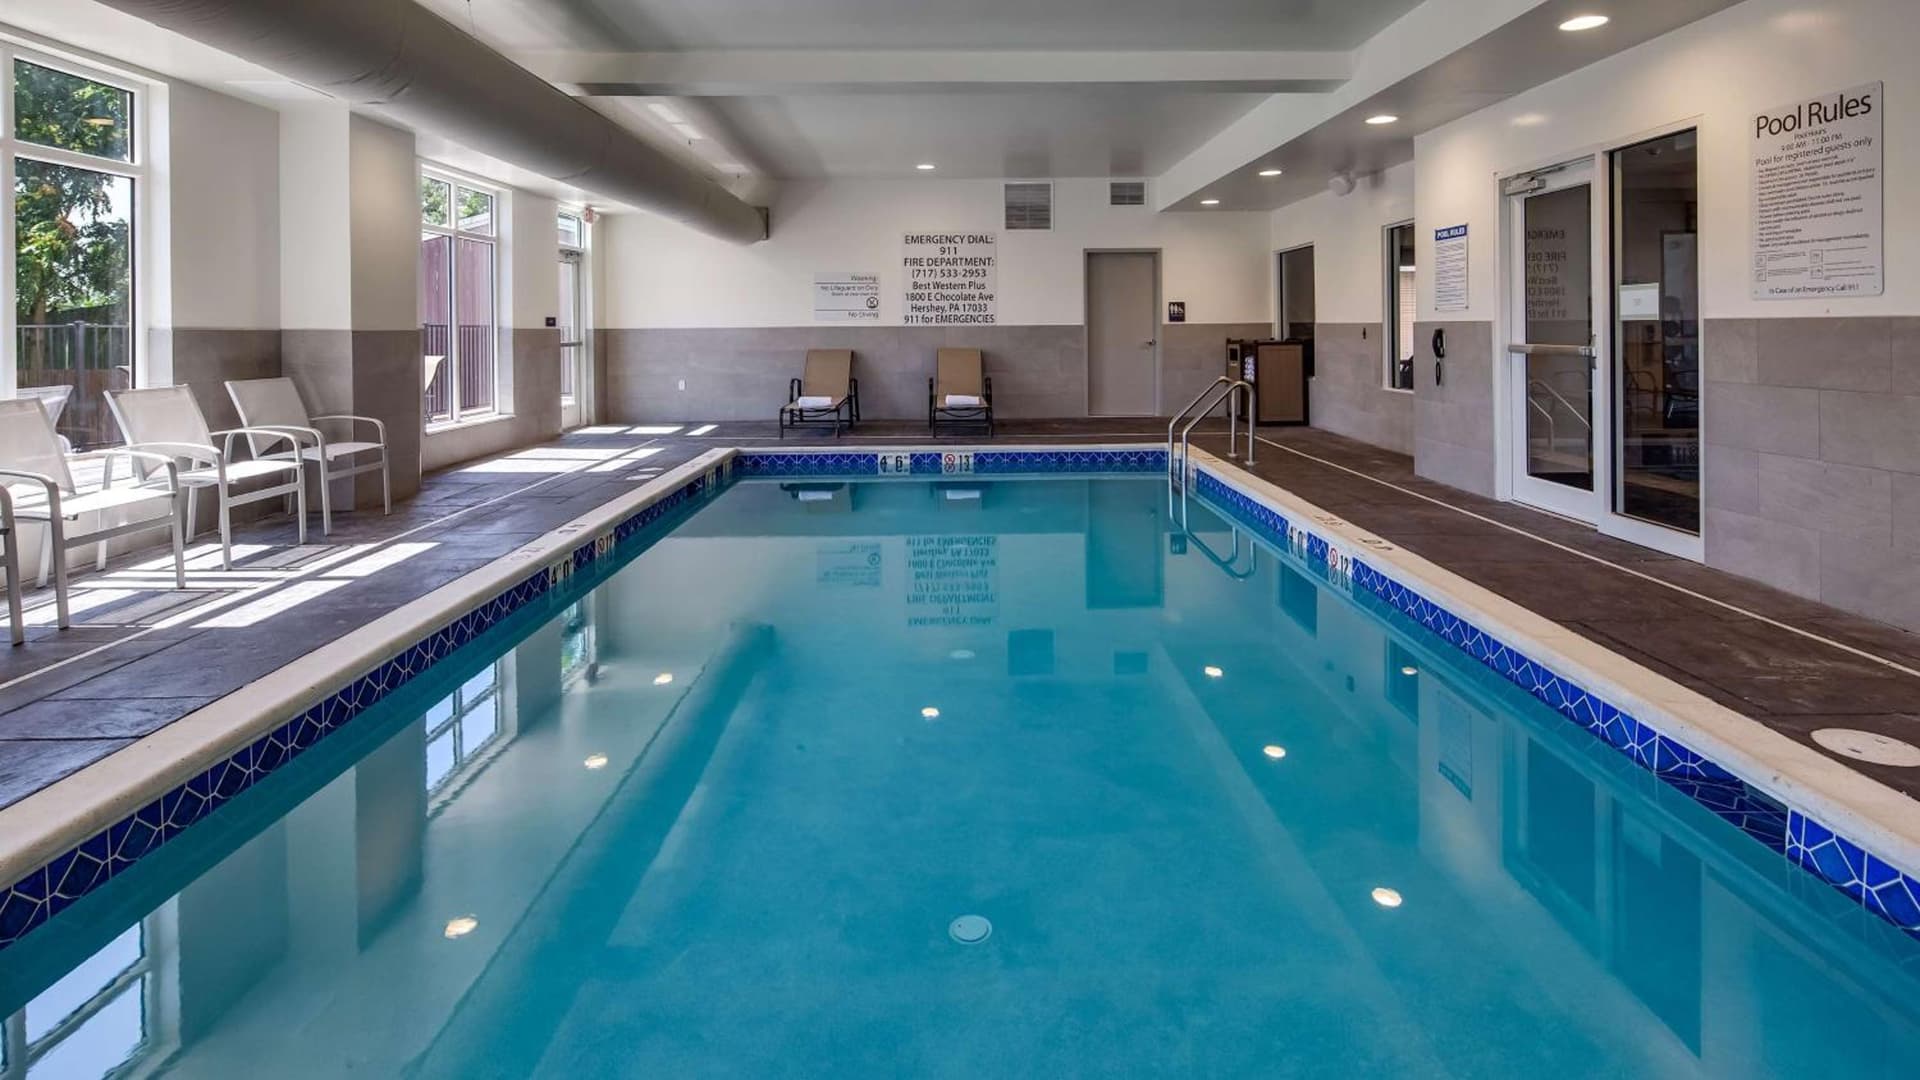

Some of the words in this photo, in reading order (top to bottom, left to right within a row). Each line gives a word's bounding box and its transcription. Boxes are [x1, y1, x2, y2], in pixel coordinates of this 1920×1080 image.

[1756, 104, 1802, 139] Pool
[1807, 94, 1872, 127] Rules
[1795, 141, 1807, 150] AM
[1831, 132, 1843, 142] PM
[1756, 156, 1772, 167] Pool
[1773, 154, 1785, 164] for
[1785, 145, 1823, 162] registered
[1824, 140, 1852, 155] guests
[1852, 135, 1873, 149] only
[904, 234, 966, 244] EMERGENCY
[967, 234, 994, 244] DIAL:
[1437, 230, 1449, 240] POOL
[939, 246, 957, 255] 911
[904, 257, 924, 266] FIRE
[926, 257, 995, 266] DEPARTMENT:
[912, 268, 938, 279] (717)
[940, 268, 987, 278] 533-2953
[912, 281, 931, 290] Best
[932, 281, 967, 290] Western
[968, 280, 986, 290] Plus
[1802, 285, 1834, 296] Emergency
[905, 292, 926, 301] 1800
[927, 292, 932, 301] E
[934, 291, 977, 302] Chocolate
[977, 292, 994, 302] Ave
[910, 303, 947, 313] Hershey,
[949, 303, 960, 312] PA
[962, 303, 988, 313] 17033
[904, 315, 919, 324] 911
[921, 314, 934, 324] for
[935, 314, 995, 324] EMERGENCIES
